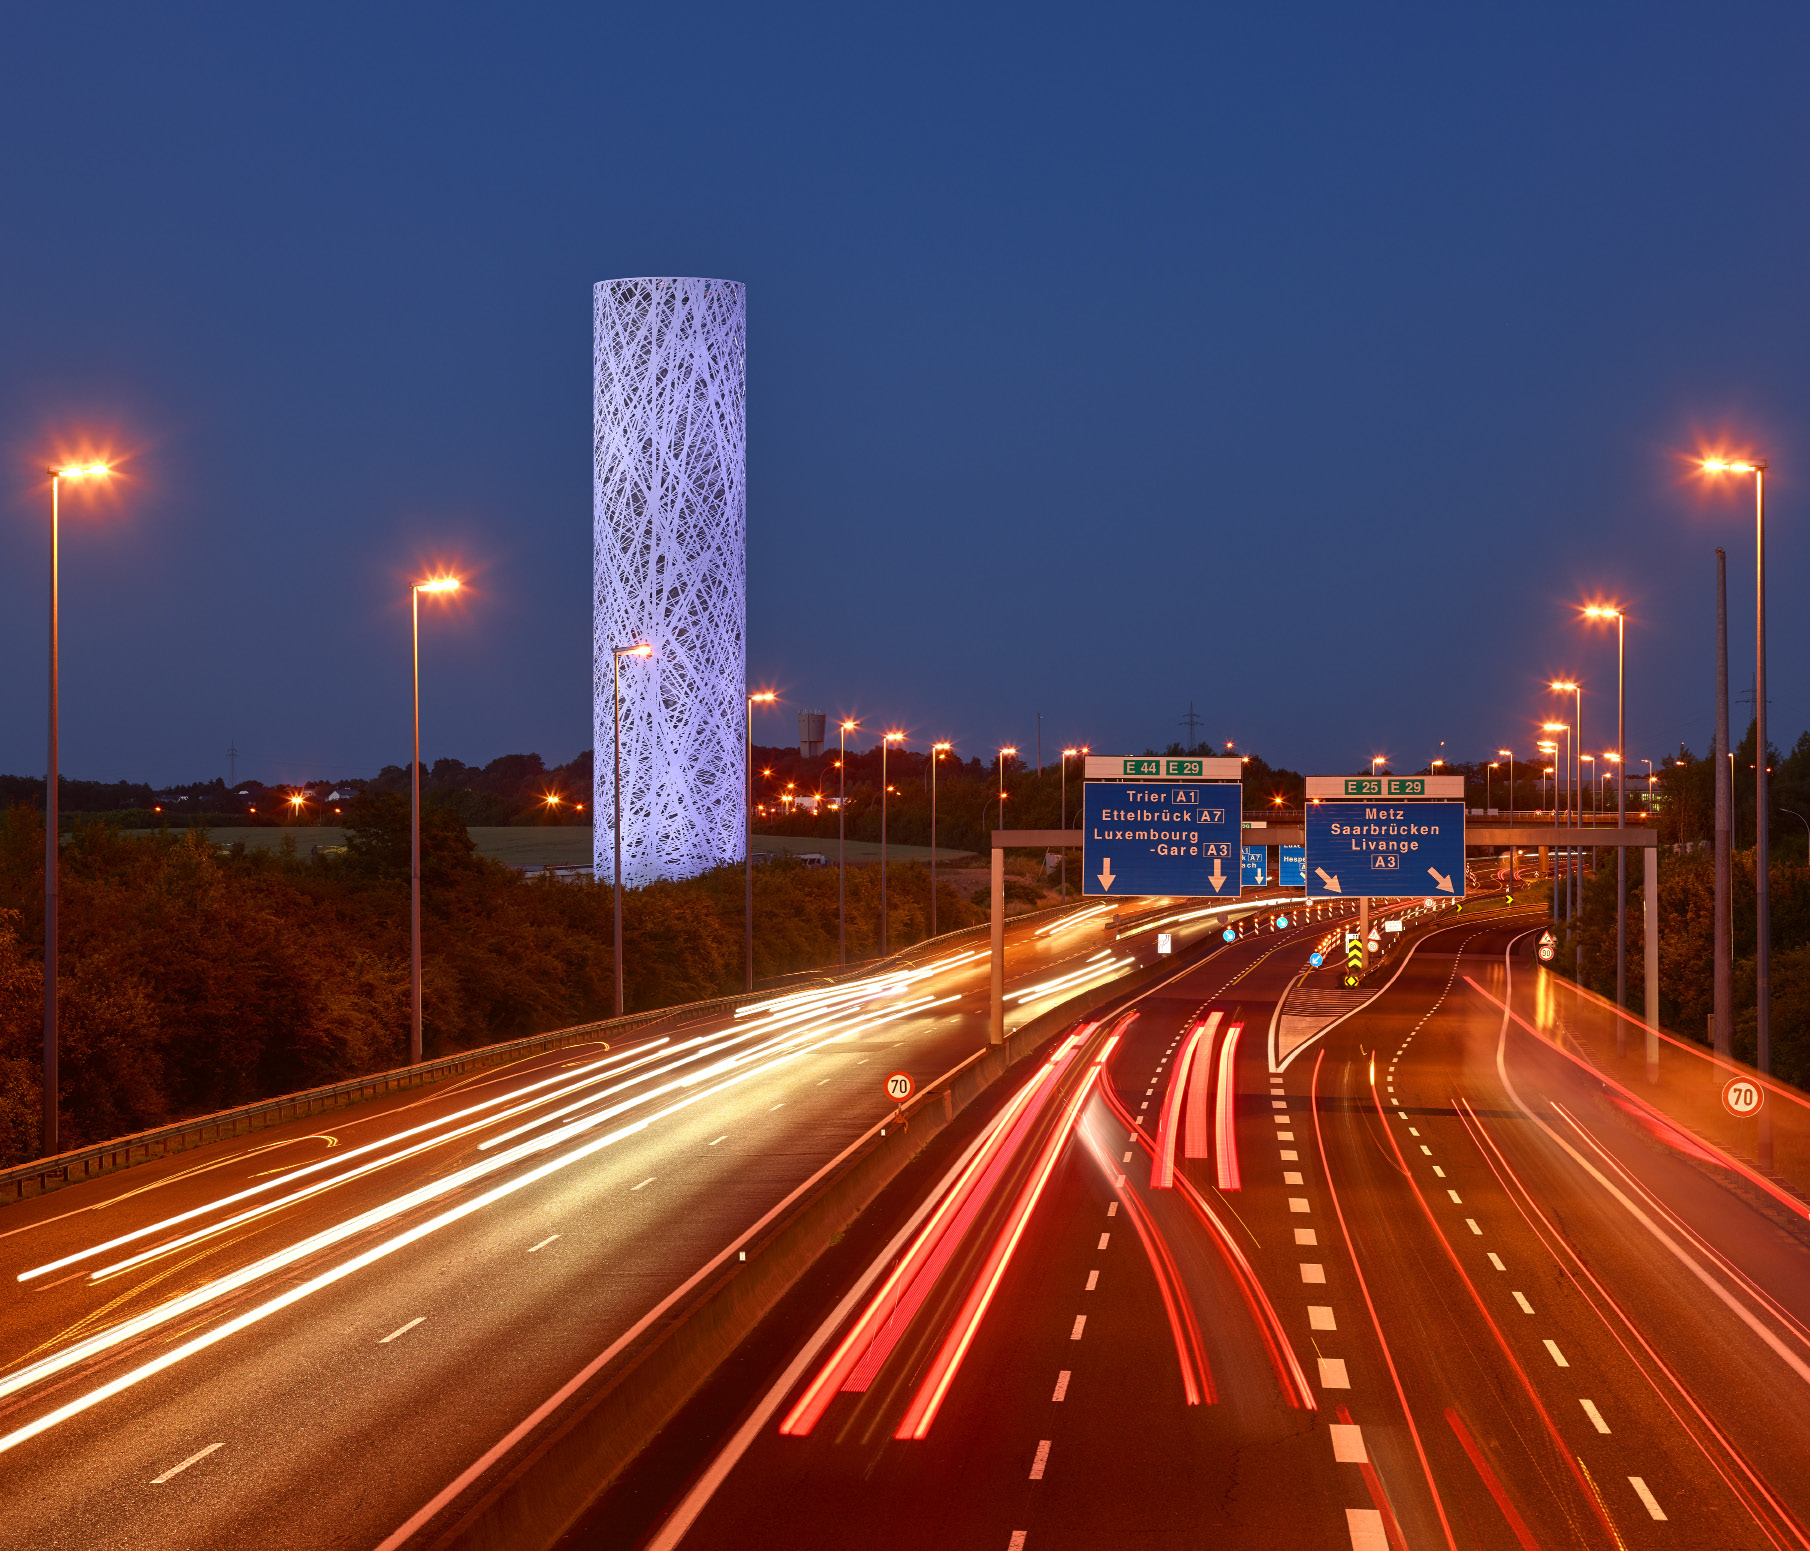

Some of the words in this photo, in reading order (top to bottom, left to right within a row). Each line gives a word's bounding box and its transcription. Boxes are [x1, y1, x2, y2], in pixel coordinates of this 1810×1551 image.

[1126, 761, 1136, 774] E
[1140, 762, 1157, 774] 44
[1169, 762, 1179, 774] E
[1183, 762, 1199, 774] 29
[1347, 781, 1357, 793] E
[1362, 781, 1379, 793] 25
[1390, 781, 1400, 793] E
[1405, 781, 1422, 793] 29
[1126, 790, 1167, 802] Trier
[1176, 791, 1195, 803] A1
[1102, 809, 1192, 822] Ettelbrück
[1200, 810, 1222, 822] A7
[1365, 807, 1404, 820] Metz
[1330, 823, 1440, 835] Saarbrücken
[1094, 828, 1199, 844] Luxembourg
[1150, 844, 1198, 856] -Gare
[1207, 844, 1228, 856] A3
[1351, 838, 1419, 853] Livange
[1375, 856, 1396, 868] A3
[1542, 949, 1551, 957] 90
[891, 1079, 907, 1093] 70
[1733, 1088, 1753, 1106] 70
